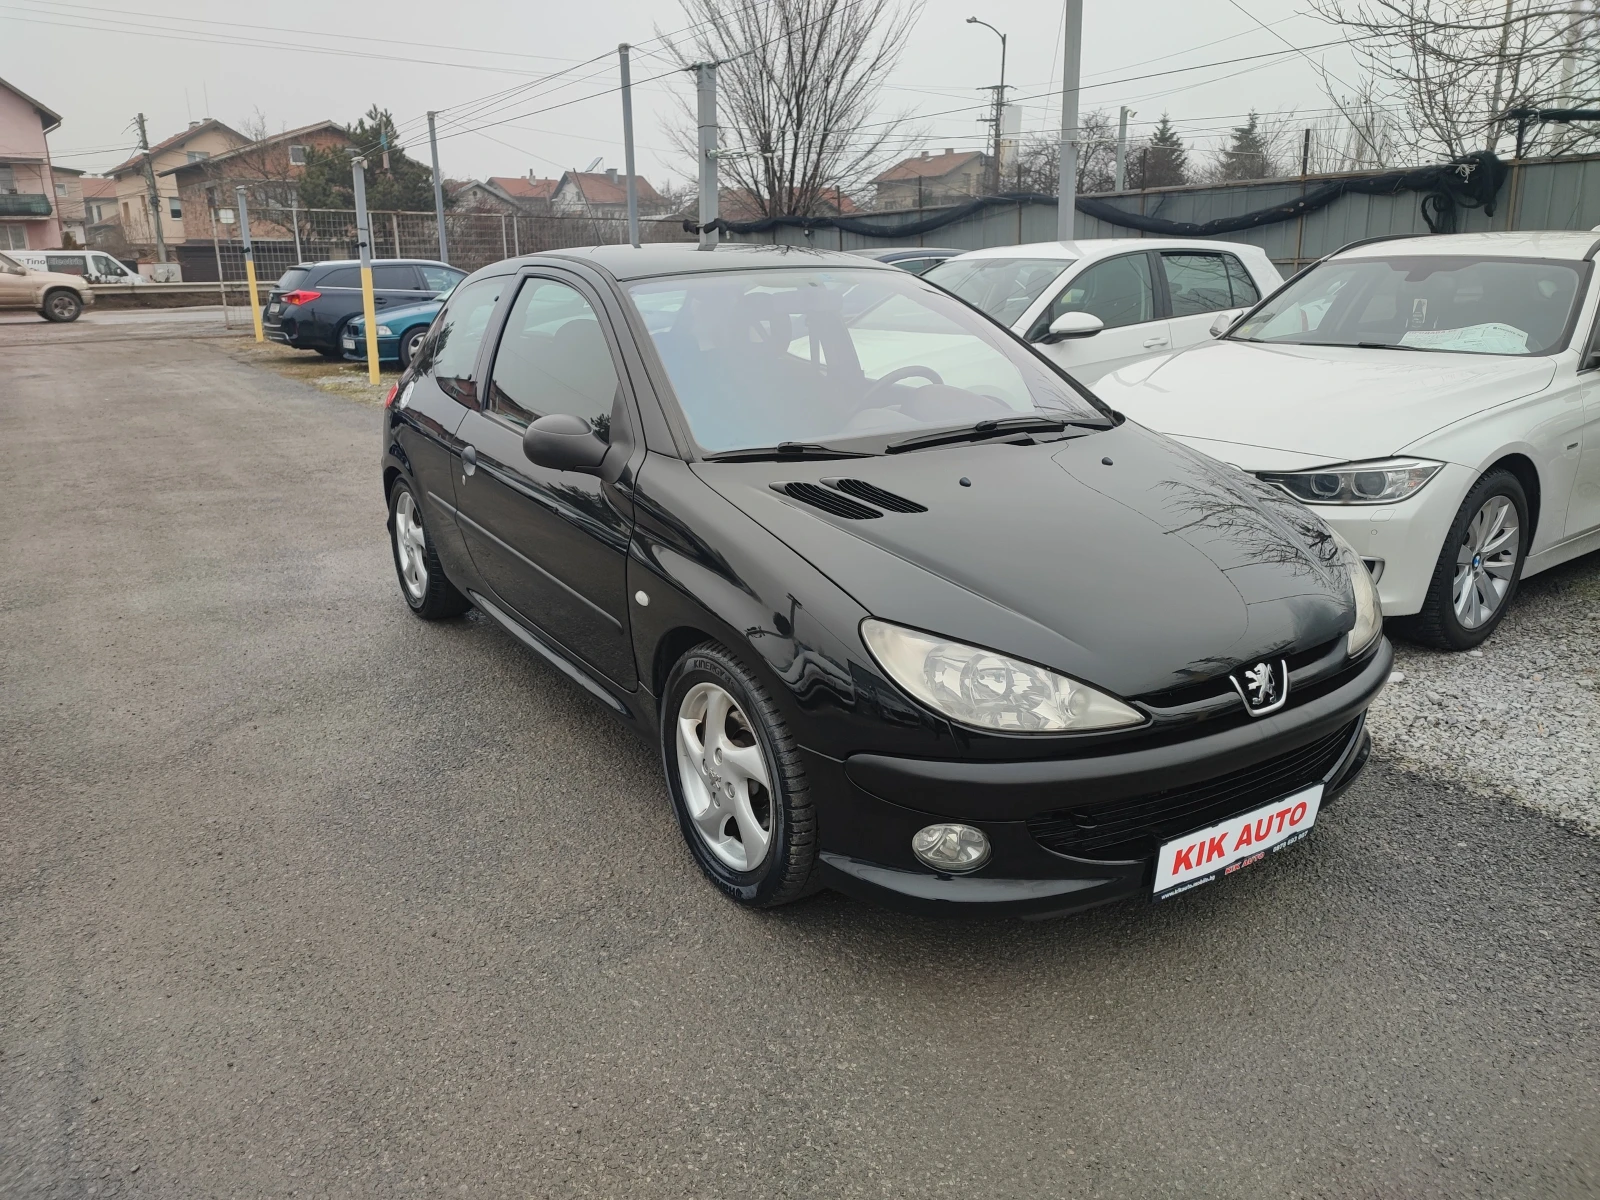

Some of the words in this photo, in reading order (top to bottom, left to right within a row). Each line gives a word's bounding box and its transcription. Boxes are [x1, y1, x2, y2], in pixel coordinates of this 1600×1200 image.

[694, 660, 725, 677] KINERGY
[1172, 832, 1229, 876] KIK
[1233, 801, 1308, 852] AUTO
[1224, 861, 1242, 876] KIK
[1241, 851, 1265, 868] AUTO
